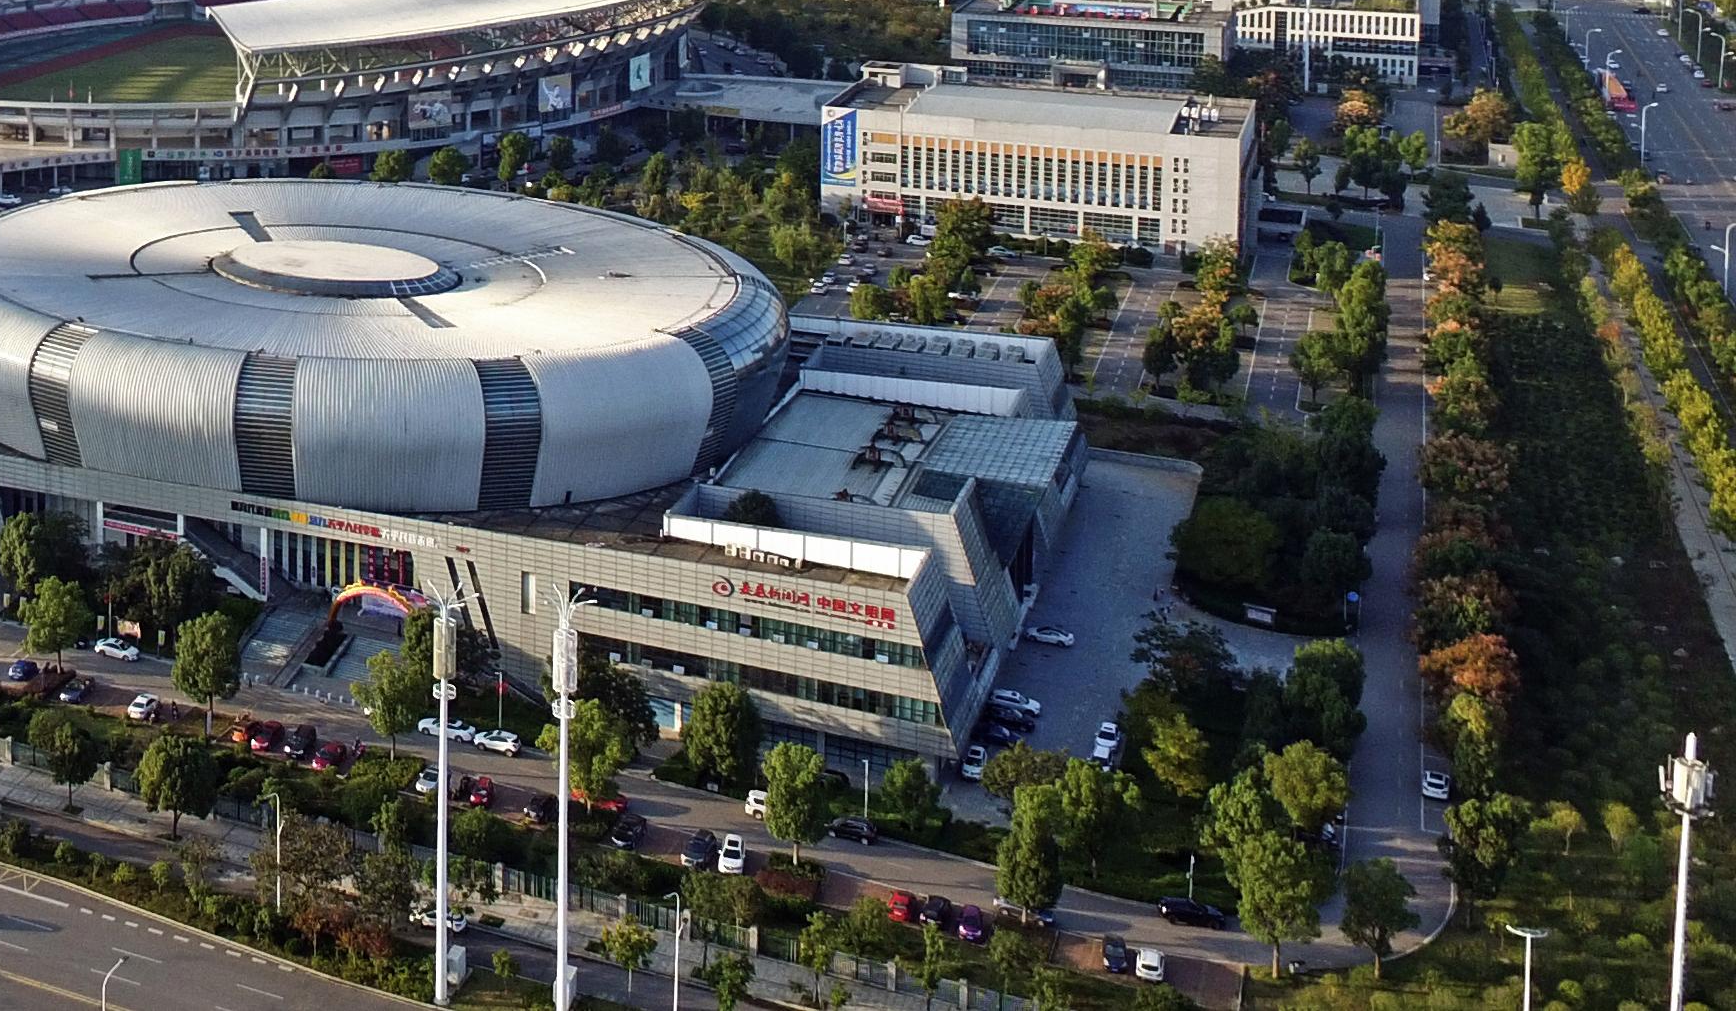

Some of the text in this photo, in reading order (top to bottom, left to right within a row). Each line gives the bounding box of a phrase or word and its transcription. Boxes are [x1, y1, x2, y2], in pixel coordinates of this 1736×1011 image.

[817, 595, 895, 621] 中国文明网
